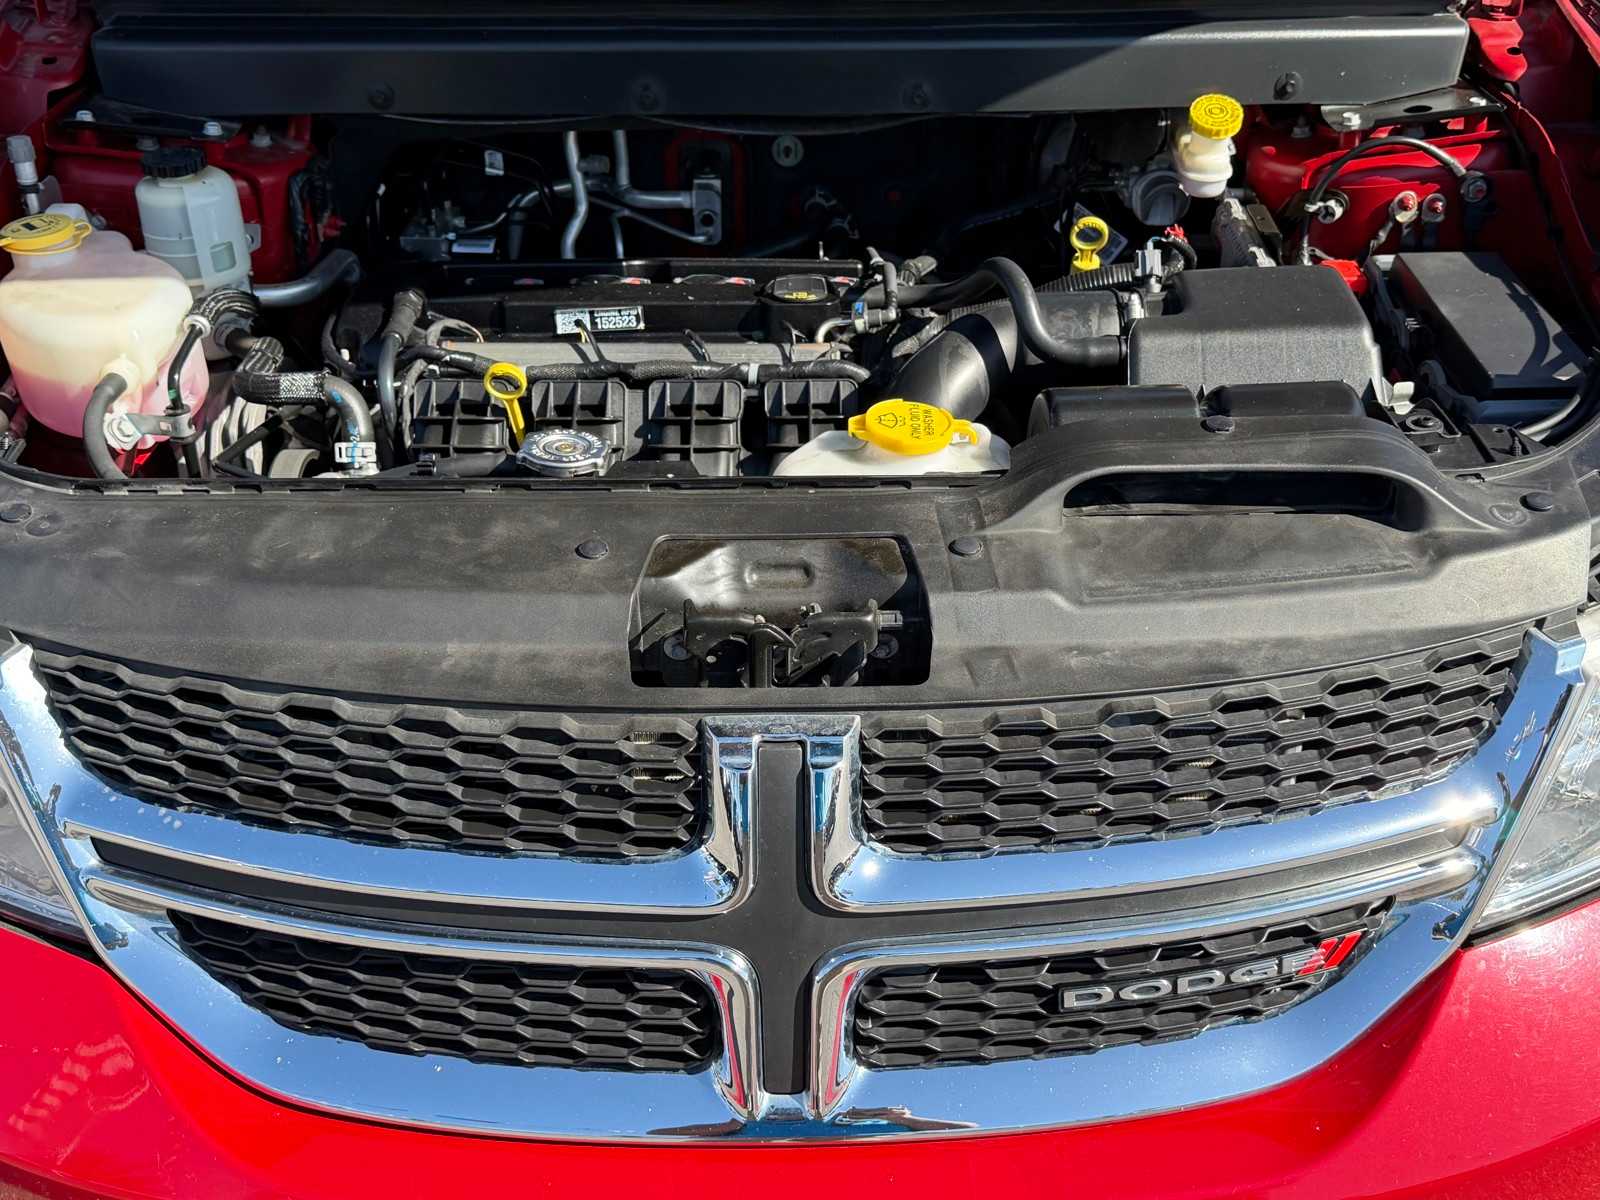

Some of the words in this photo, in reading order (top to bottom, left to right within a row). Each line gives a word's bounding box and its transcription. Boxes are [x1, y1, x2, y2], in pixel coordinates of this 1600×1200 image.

[595, 315, 637, 330] 152523
[909, 404, 920, 422] FLUID
[910, 423, 922, 440] ONLY
[923, 409, 935, 436] WASHER
[1063, 945, 1323, 1009] DODGE
